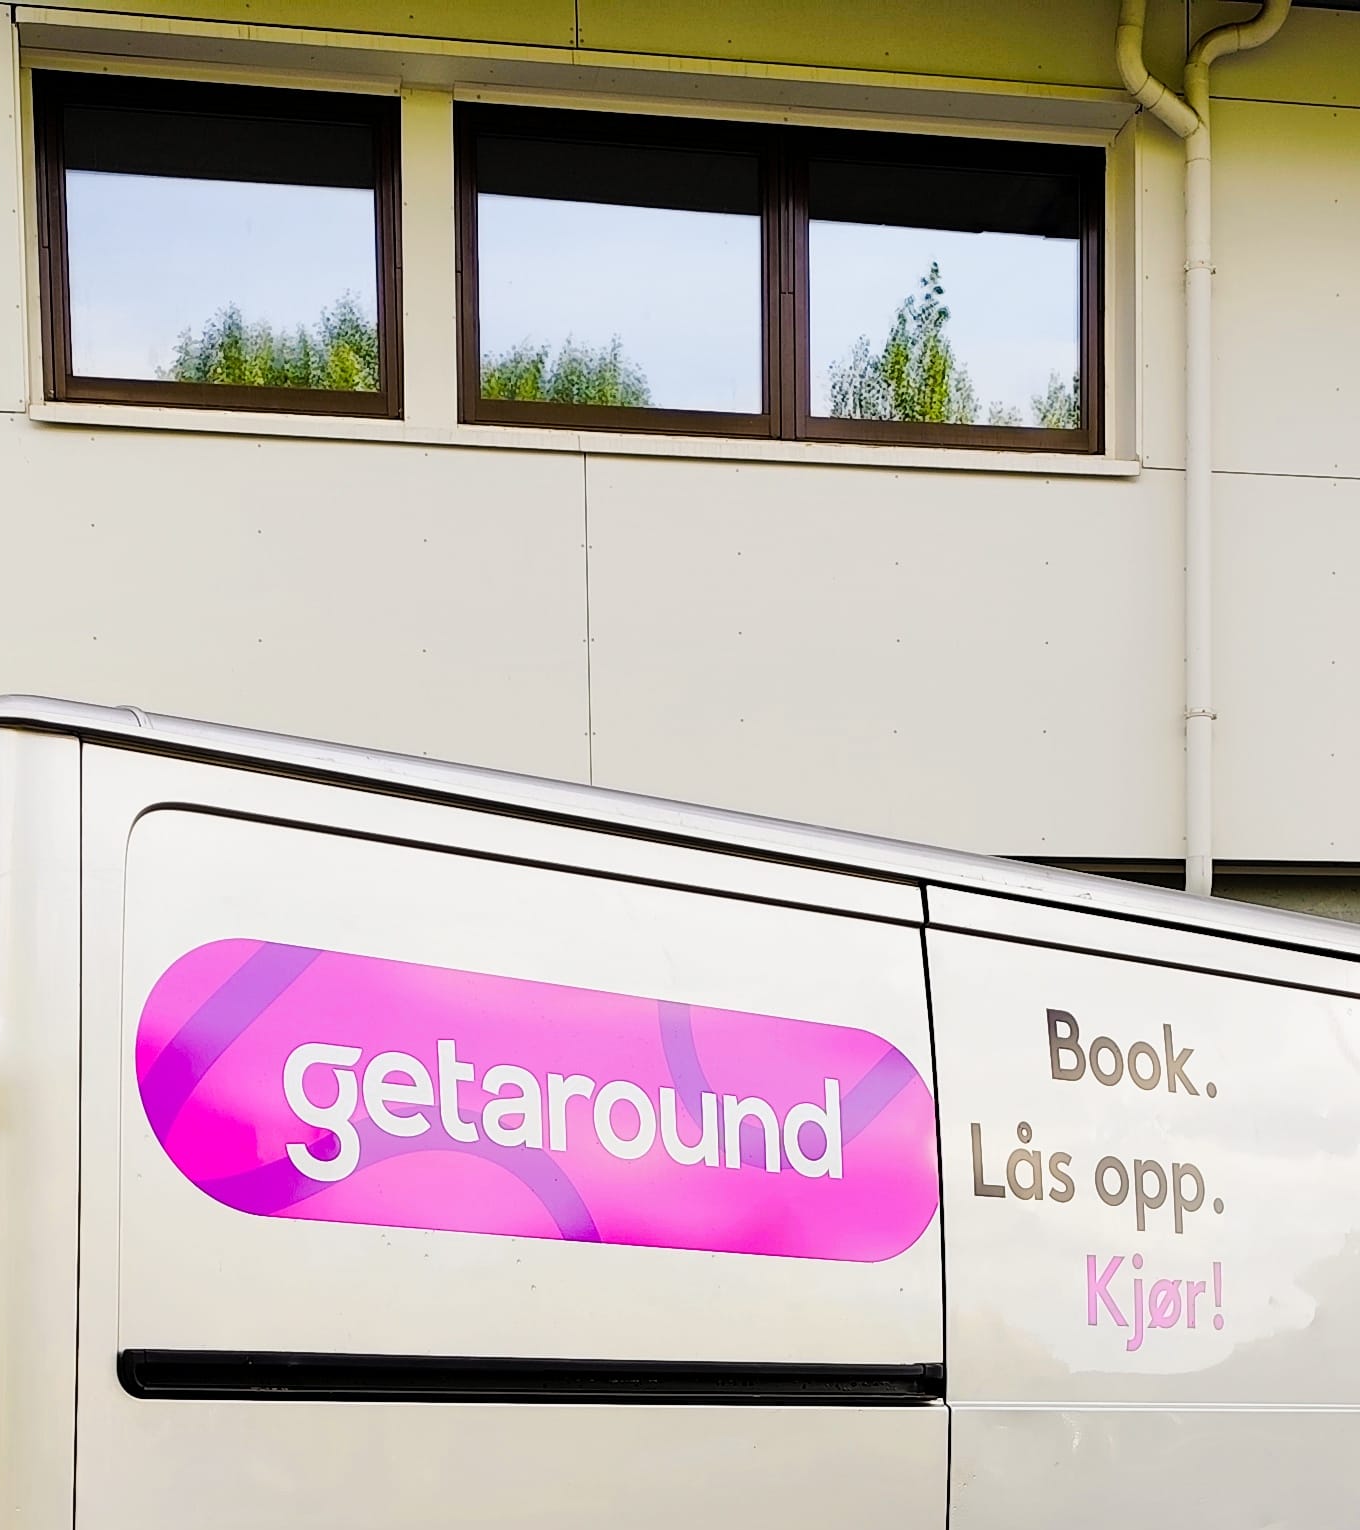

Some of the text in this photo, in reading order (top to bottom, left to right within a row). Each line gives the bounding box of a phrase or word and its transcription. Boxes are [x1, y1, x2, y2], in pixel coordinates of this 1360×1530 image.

[1046, 1008, 1218, 1099] Book.
[283, 1038, 844, 1182] getaround
[970, 1121, 1225, 1234] Lås opp.
[1086, 1253, 1225, 1352] Kjør!
